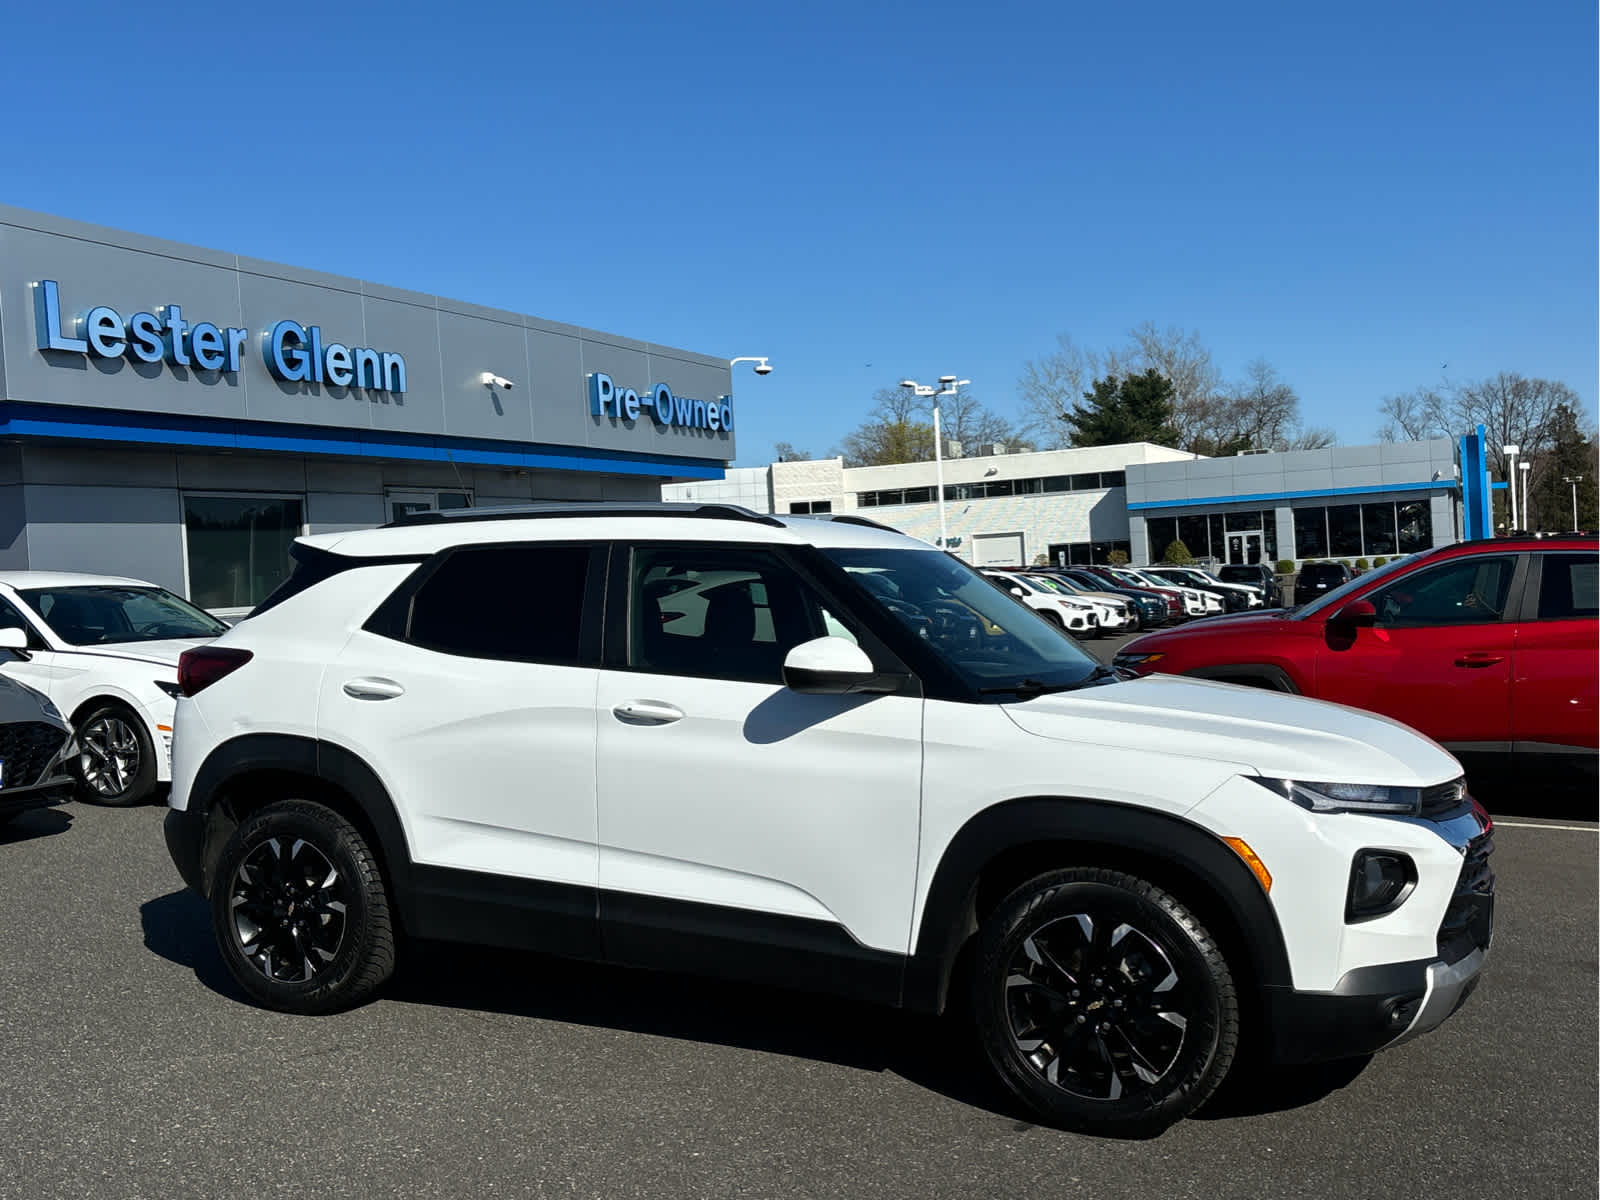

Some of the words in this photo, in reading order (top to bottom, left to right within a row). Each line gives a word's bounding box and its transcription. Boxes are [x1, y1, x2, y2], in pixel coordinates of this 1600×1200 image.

[34, 279, 248, 373] Lester
[264, 319, 408, 394] Glenn
[589, 372, 733, 433] Pre-Owned
